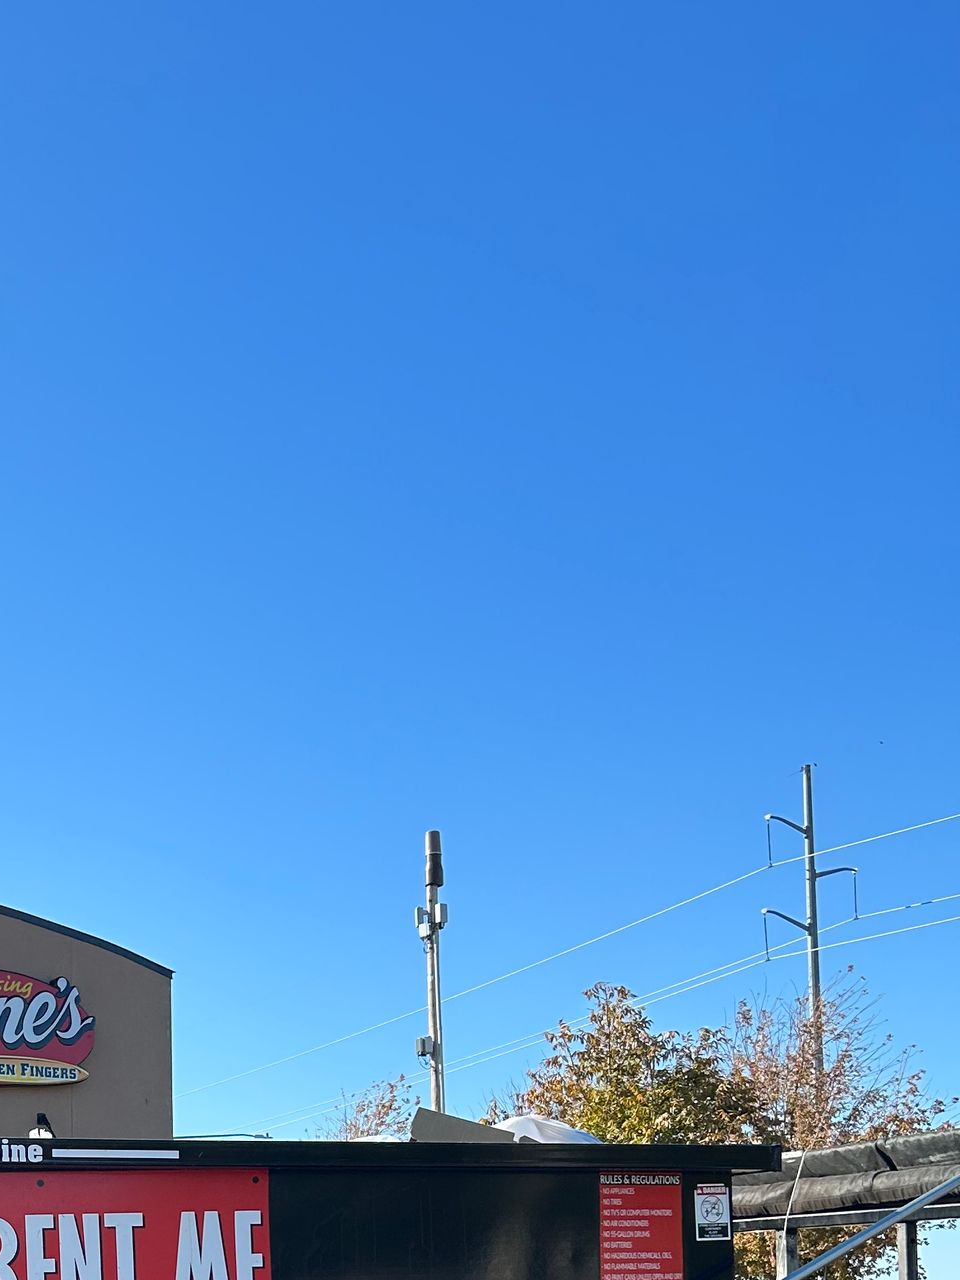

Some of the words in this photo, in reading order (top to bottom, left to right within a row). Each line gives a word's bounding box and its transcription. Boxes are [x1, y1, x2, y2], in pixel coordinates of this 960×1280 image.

[20, 1063, 78, 1080] FINGERS
[600, 1175, 622, 1185] RULES
[623, 1175, 630, 1185] &
[631, 1175, 680, 1185] REGULATIONS
